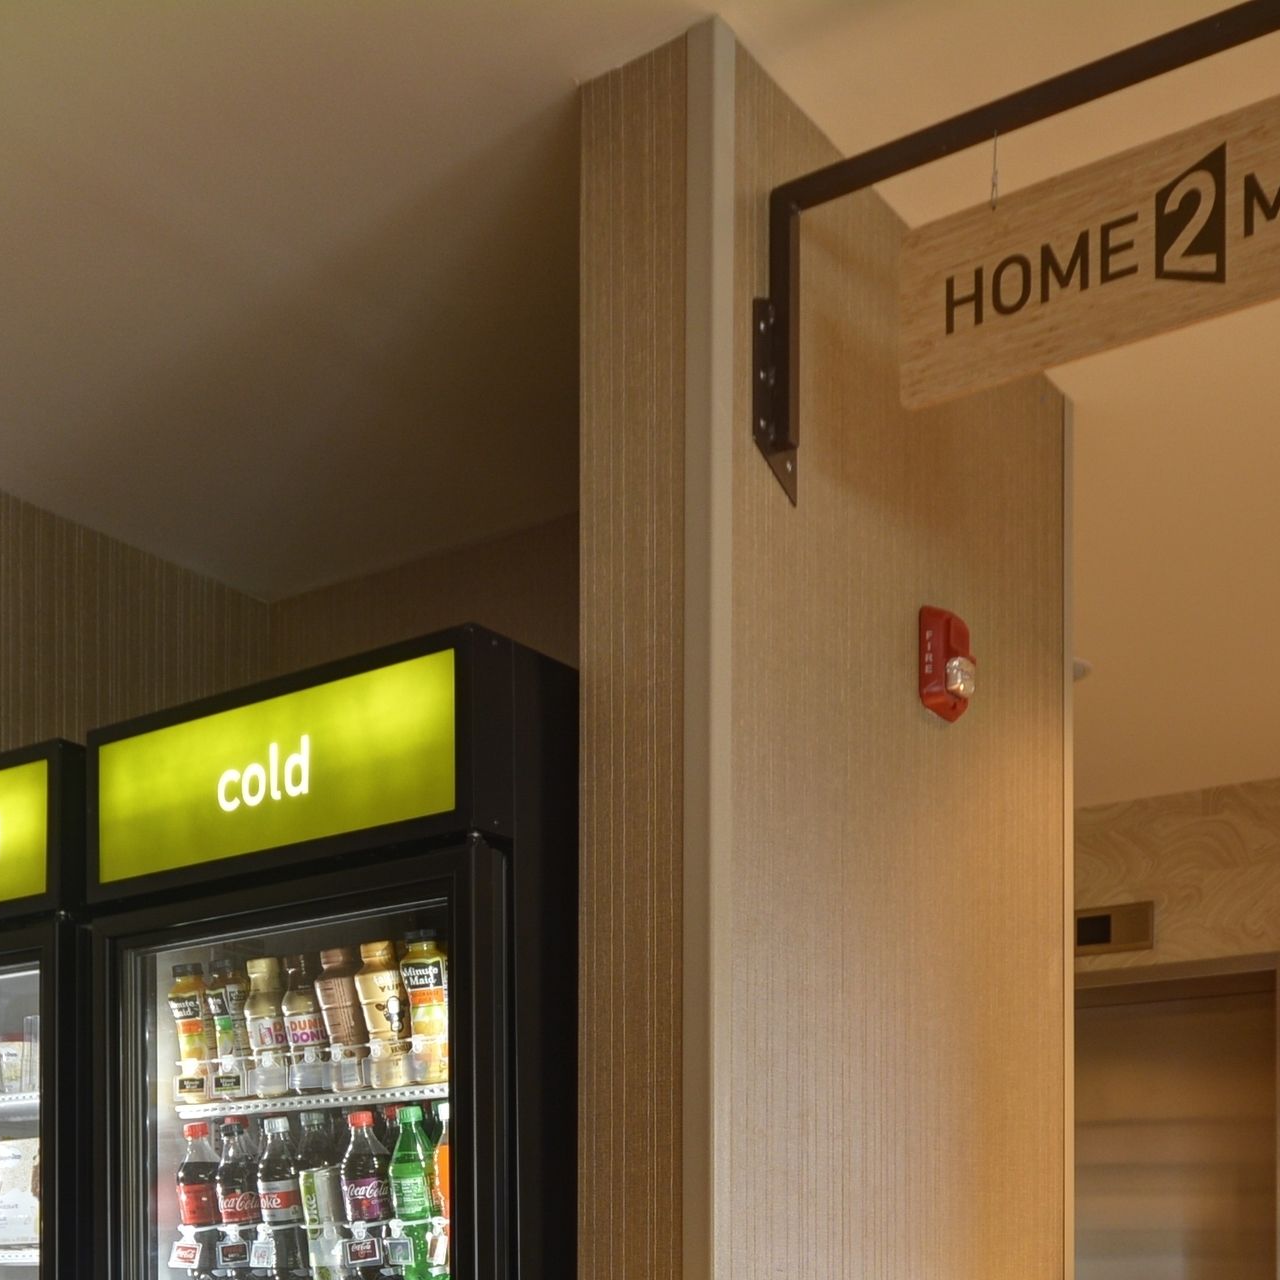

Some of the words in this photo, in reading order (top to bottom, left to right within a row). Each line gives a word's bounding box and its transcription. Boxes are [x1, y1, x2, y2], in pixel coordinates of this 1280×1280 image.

[945, 212, 1139, 335] HOME
[1161, 164, 1221, 277] 2
[925, 629, 934, 675] FIRE
[217, 735, 311, 812] cold
[260, 1196, 281, 1209] oke
